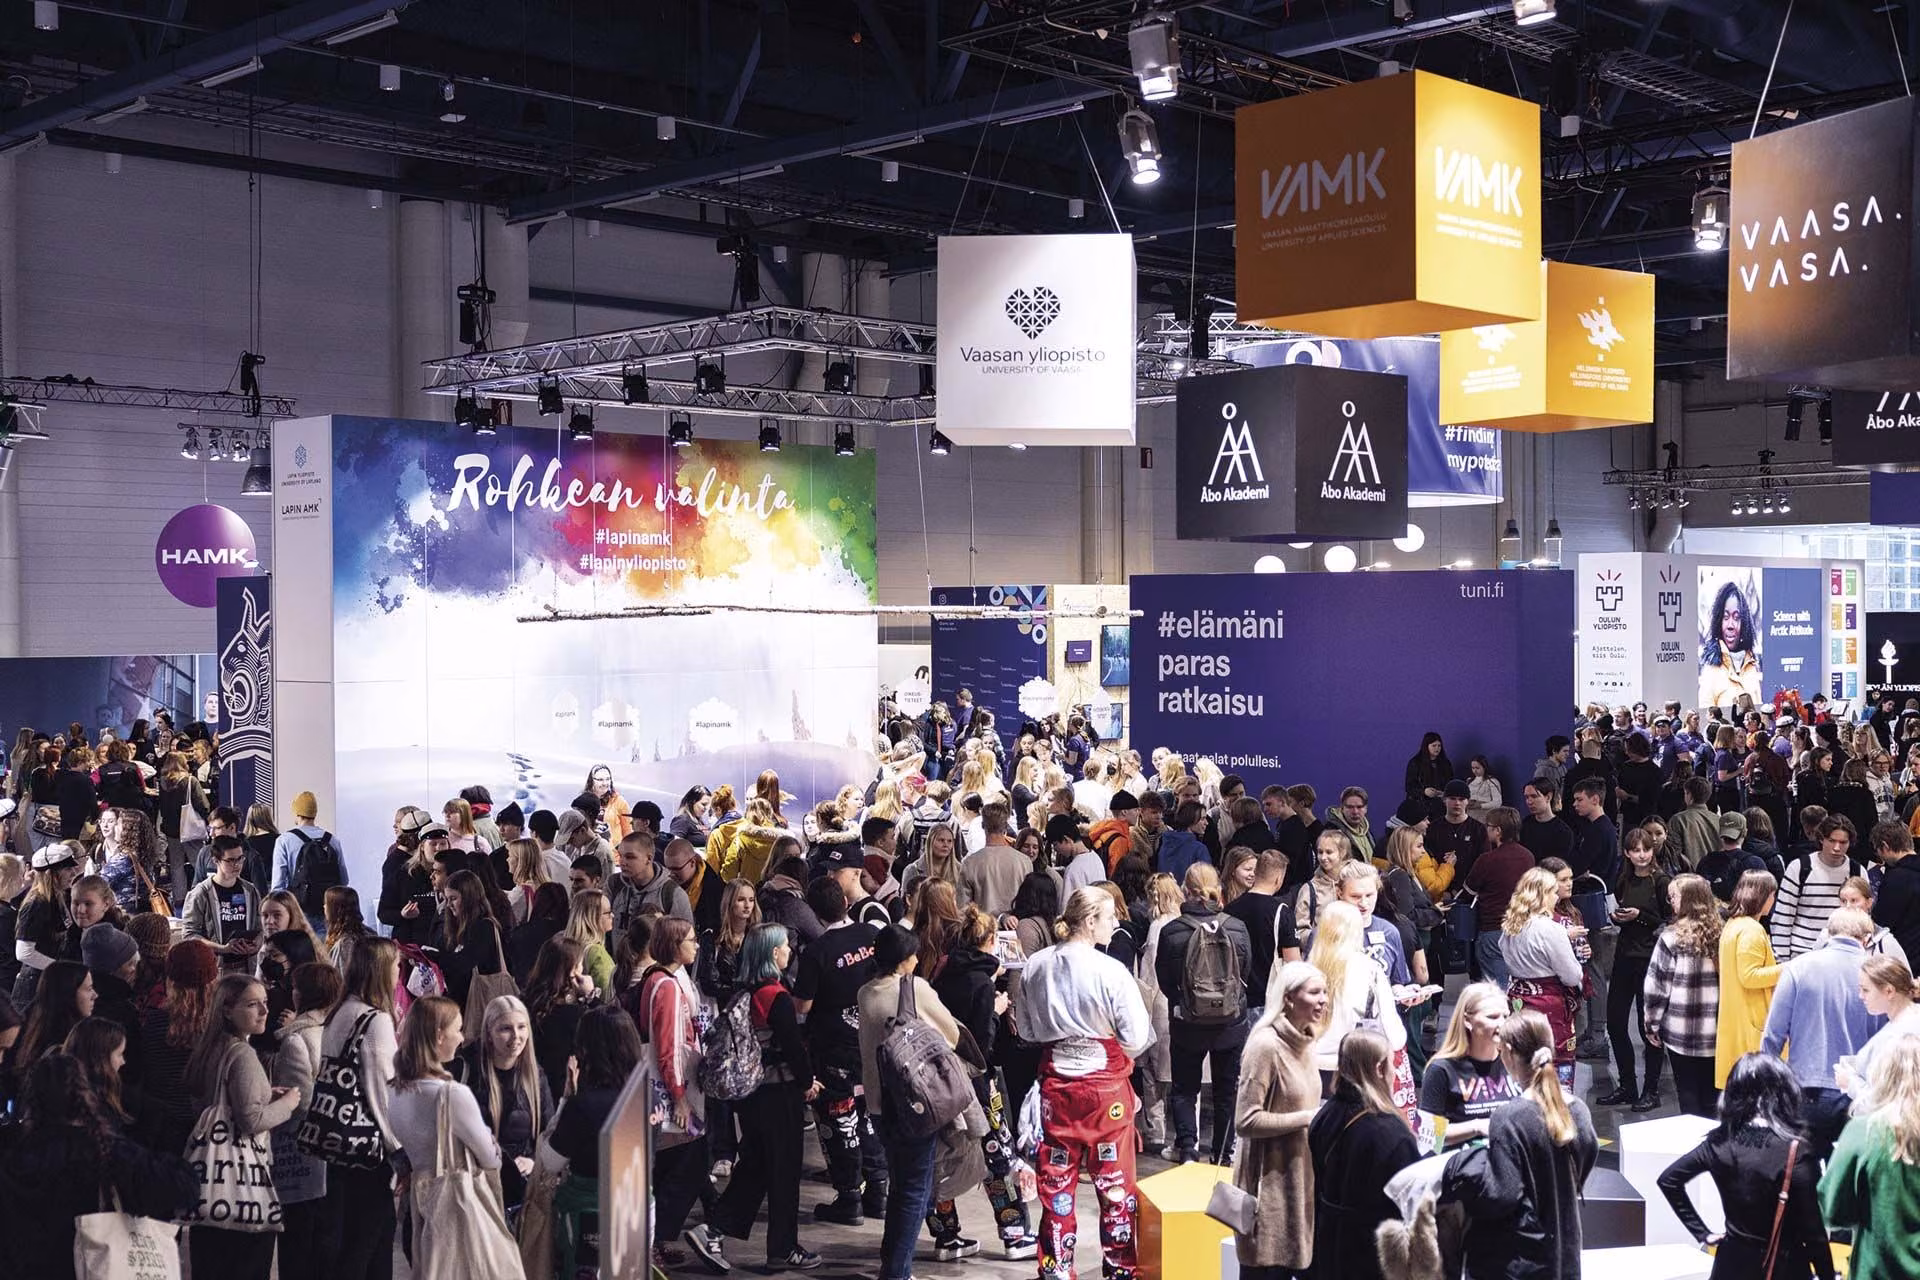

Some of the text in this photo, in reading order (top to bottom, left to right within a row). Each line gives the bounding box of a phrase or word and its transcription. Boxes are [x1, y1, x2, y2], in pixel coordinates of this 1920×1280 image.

[1261, 147, 1386, 219] VAMK
[1434, 145, 1523, 217] VAMK
[960, 347, 1106, 366] Vaasan yliopisto
[982, 366, 1034, 374] UNIVERSITY
[1037, 366, 1049, 374] OF
[1866, 414, 1894, 429] Åbo
[447, 453, 796, 520] Rohkean valinta
[1201, 485, 1269, 503] Åbo Akademi
[1321, 482, 1386, 502] Åbo Akademi
[281, 503, 319, 515] LAPIN AMK
[596, 529, 672, 549] #lapinamk
[162, 548, 249, 565] HAMK
[580, 554, 687, 574] #lapinyliopisto
[1460, 582, 1504, 598] tuni.fi
[1158, 609, 1284, 639] #elämäni
[1661, 642, 1680, 651] OULUN
[1656, 653, 1685, 662] YLIOPISTO
[1158, 653, 1231, 681] paras
[1158, 686, 1264, 717] ratkaisu
[598, 720, 633, 729] #lapinamk
[696, 721, 732, 729] #lapinamk
[1231, 754, 1281, 768] polullesi.
